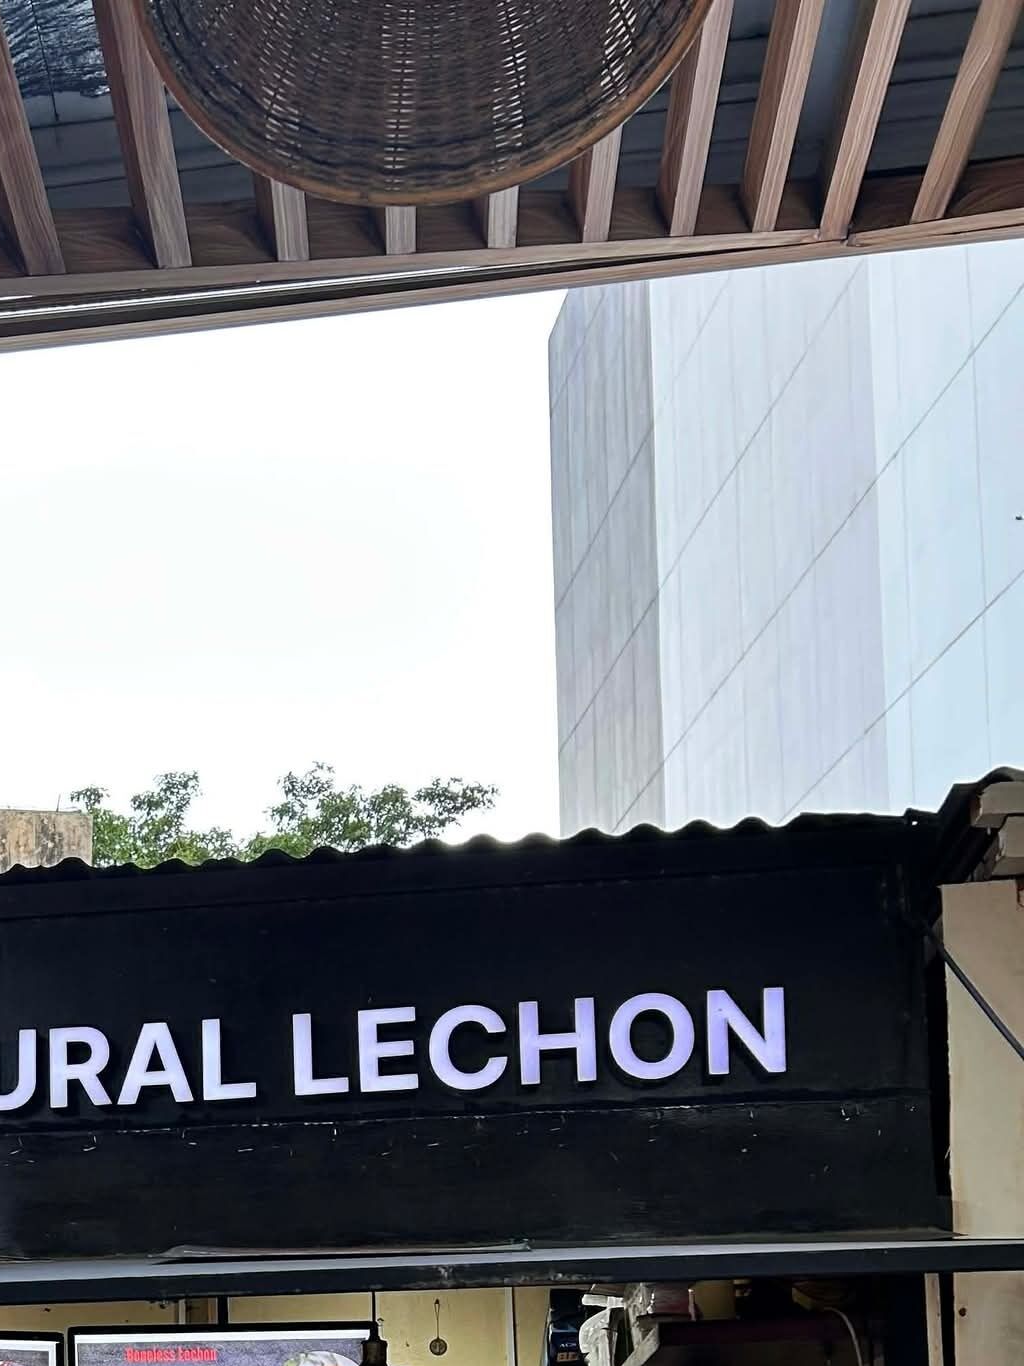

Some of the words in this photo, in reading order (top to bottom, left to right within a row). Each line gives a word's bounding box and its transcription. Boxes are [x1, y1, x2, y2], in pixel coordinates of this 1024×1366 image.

[292, 987, 787, 1097] LECHON
[125, 1347, 175, 1363] Boneless
[177, 1347, 217, 1362] Lechon
